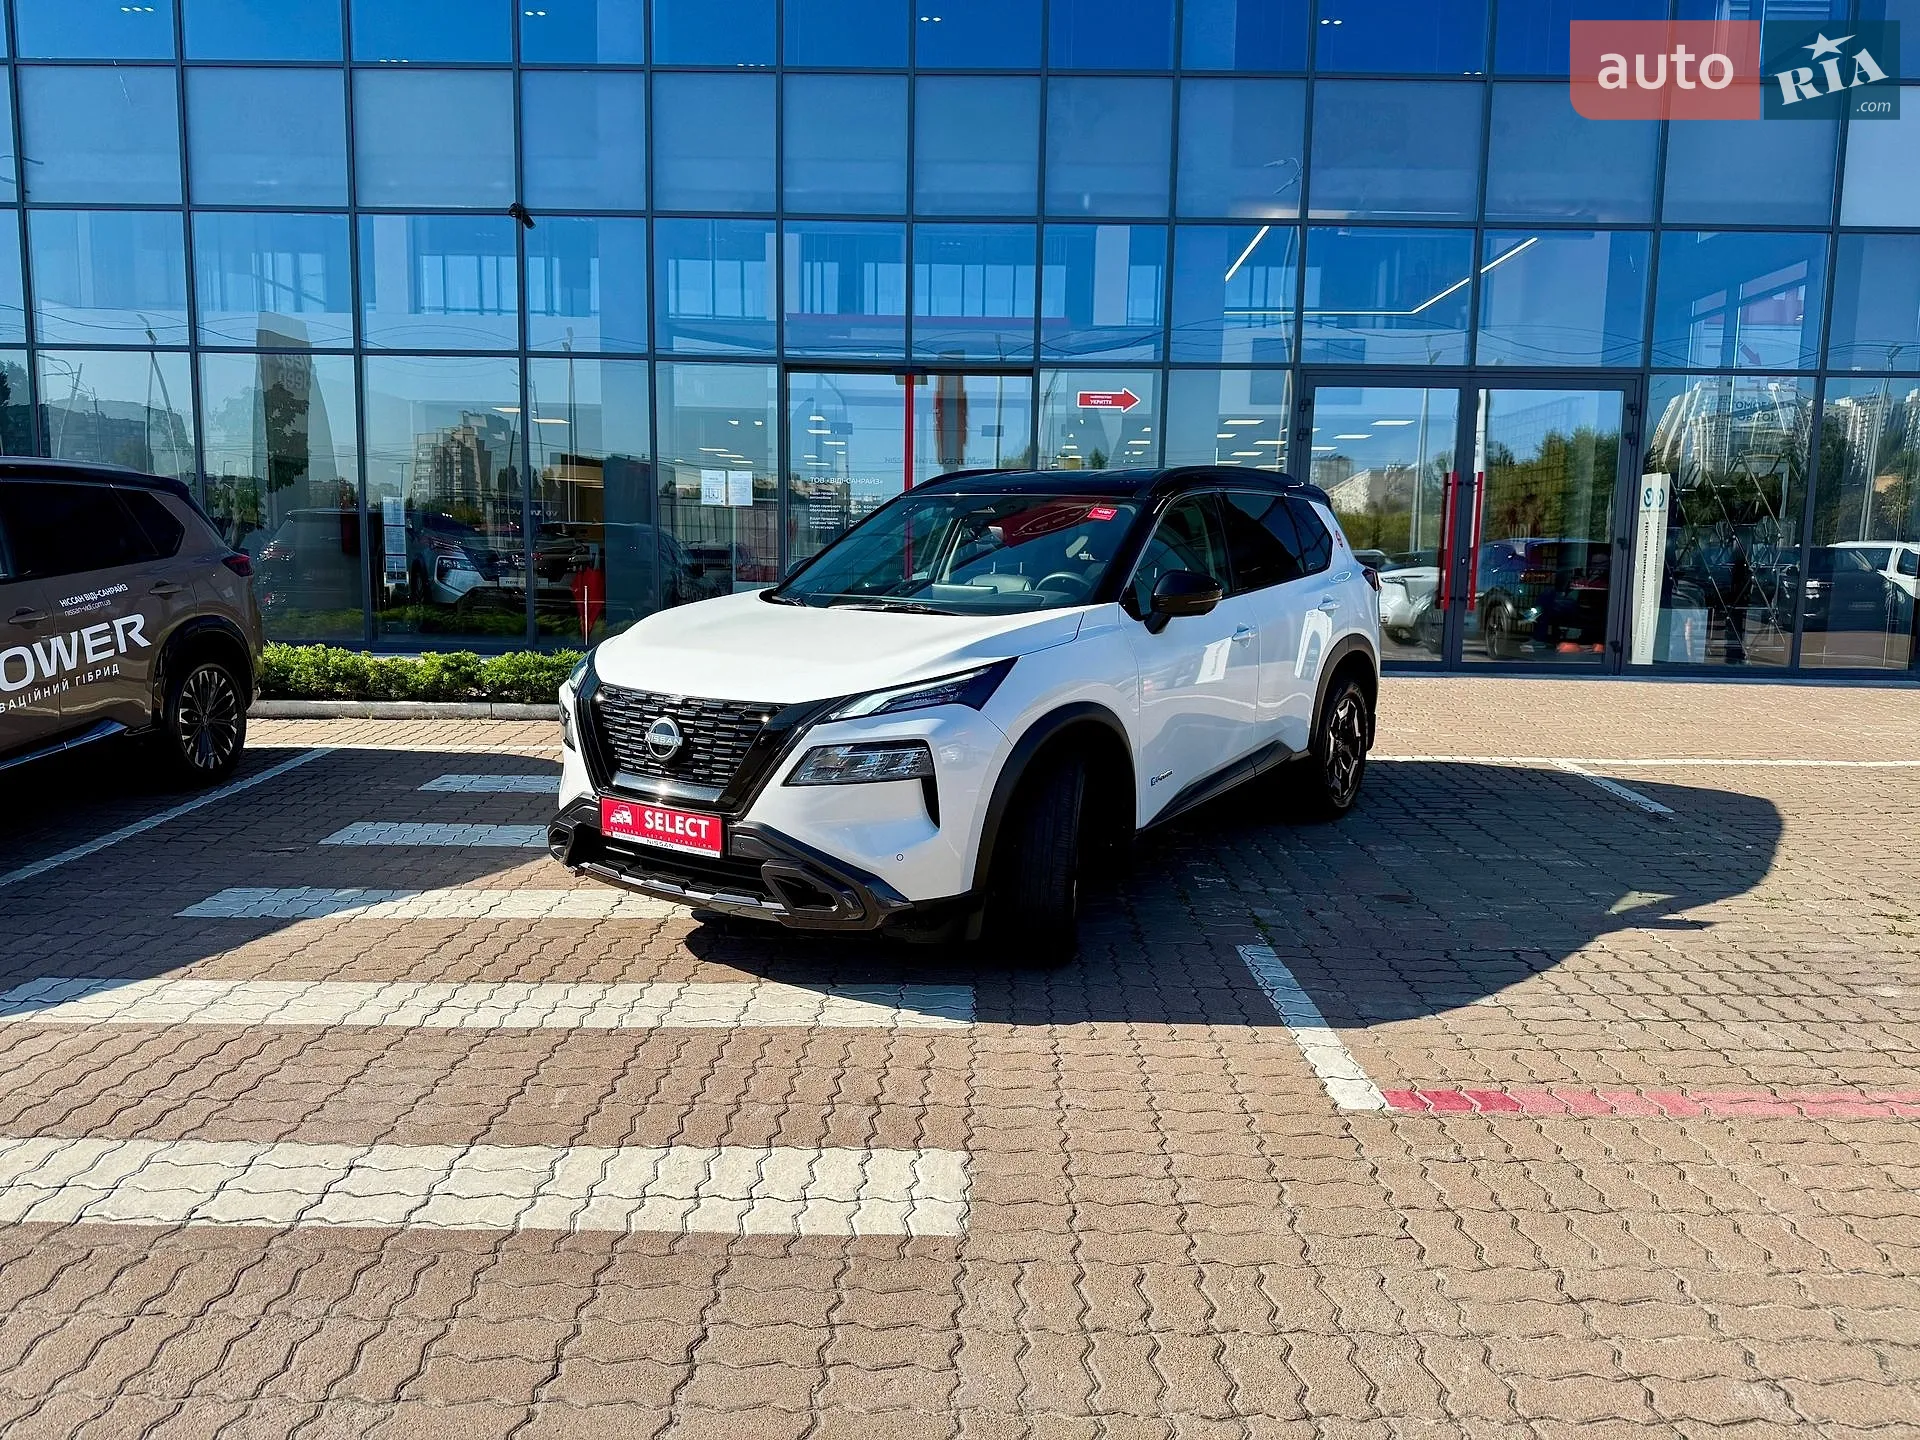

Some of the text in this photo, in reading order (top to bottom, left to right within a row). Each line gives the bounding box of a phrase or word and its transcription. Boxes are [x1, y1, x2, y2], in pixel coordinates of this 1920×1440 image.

[59, 584, 129, 607] НІССАН ВІДІ-САНРАЙЗ
[0, 613, 152, 692] OWER
[75, 663, 120, 687] ГІБРИД
[645, 733, 682, 746] NISSAN
[644, 810, 710, 839] SELECT
[646, 840, 674, 849] NISSAN
